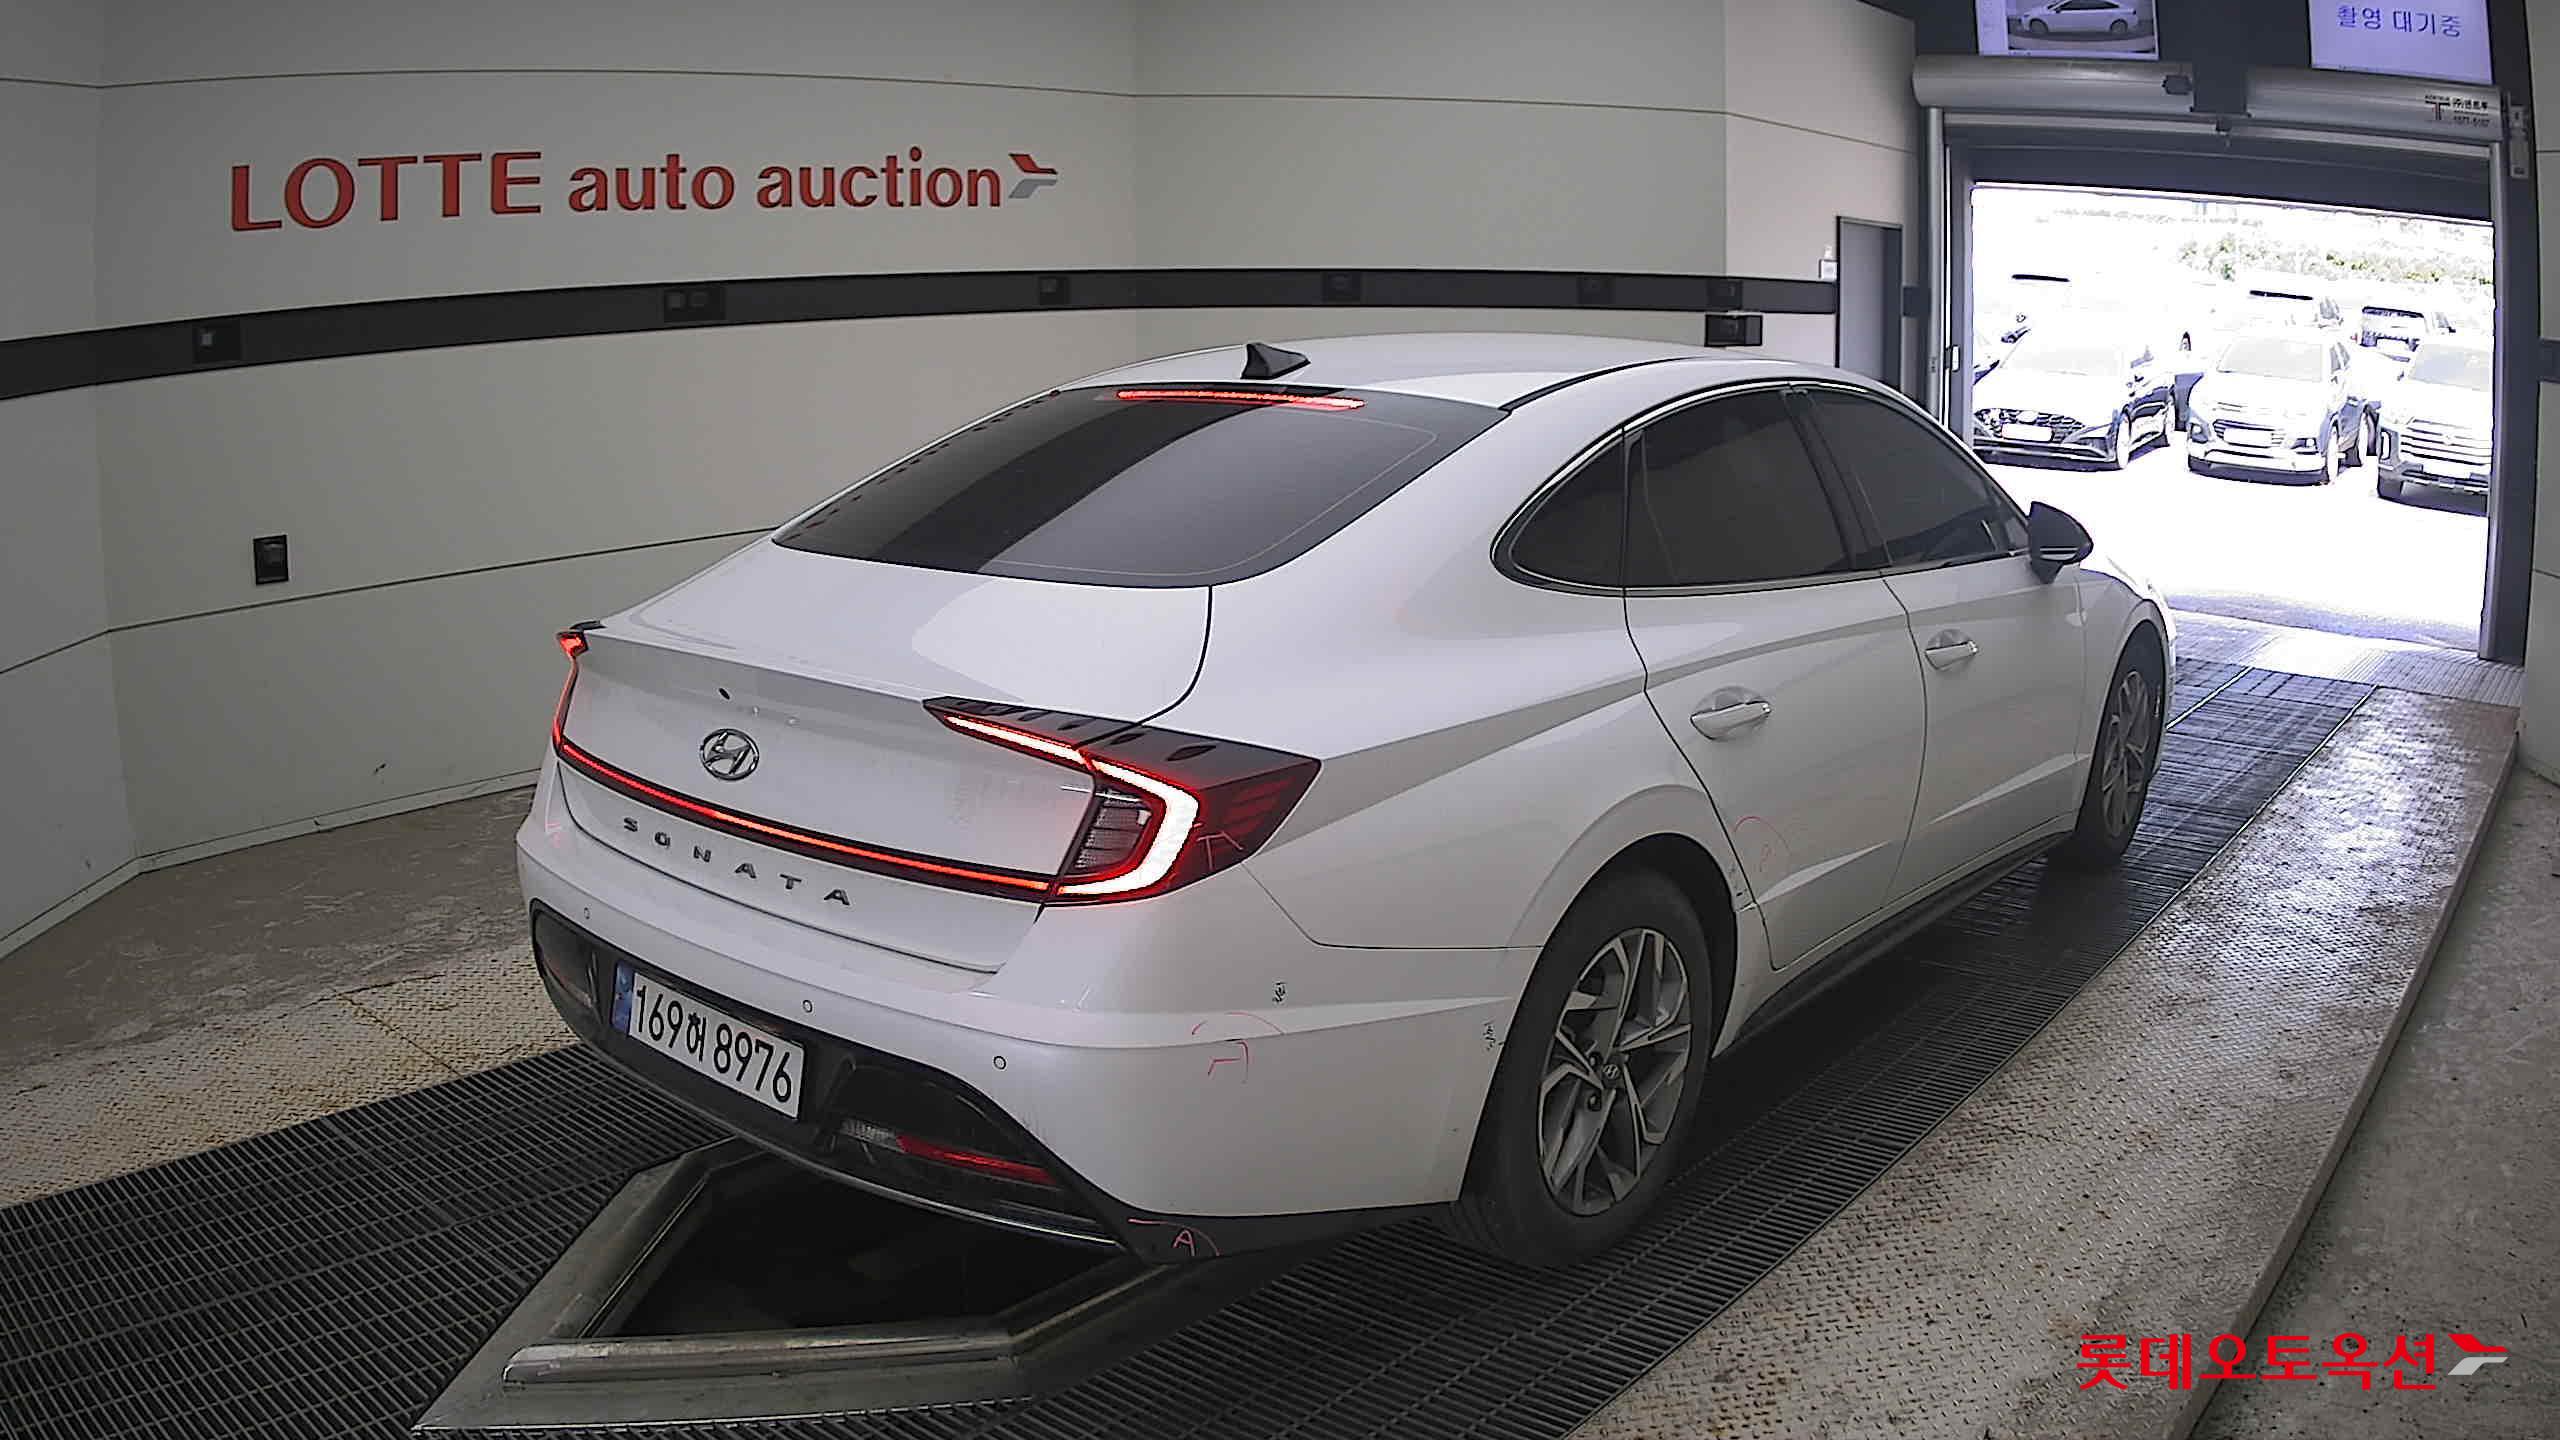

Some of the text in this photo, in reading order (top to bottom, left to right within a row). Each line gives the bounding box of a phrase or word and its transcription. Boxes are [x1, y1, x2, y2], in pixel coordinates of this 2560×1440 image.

[2337, 5, 2462, 38] 촬영 대기중
[231, 146, 1001, 232] LOTTE auto auction
[623, 817, 851, 906] SONATA
